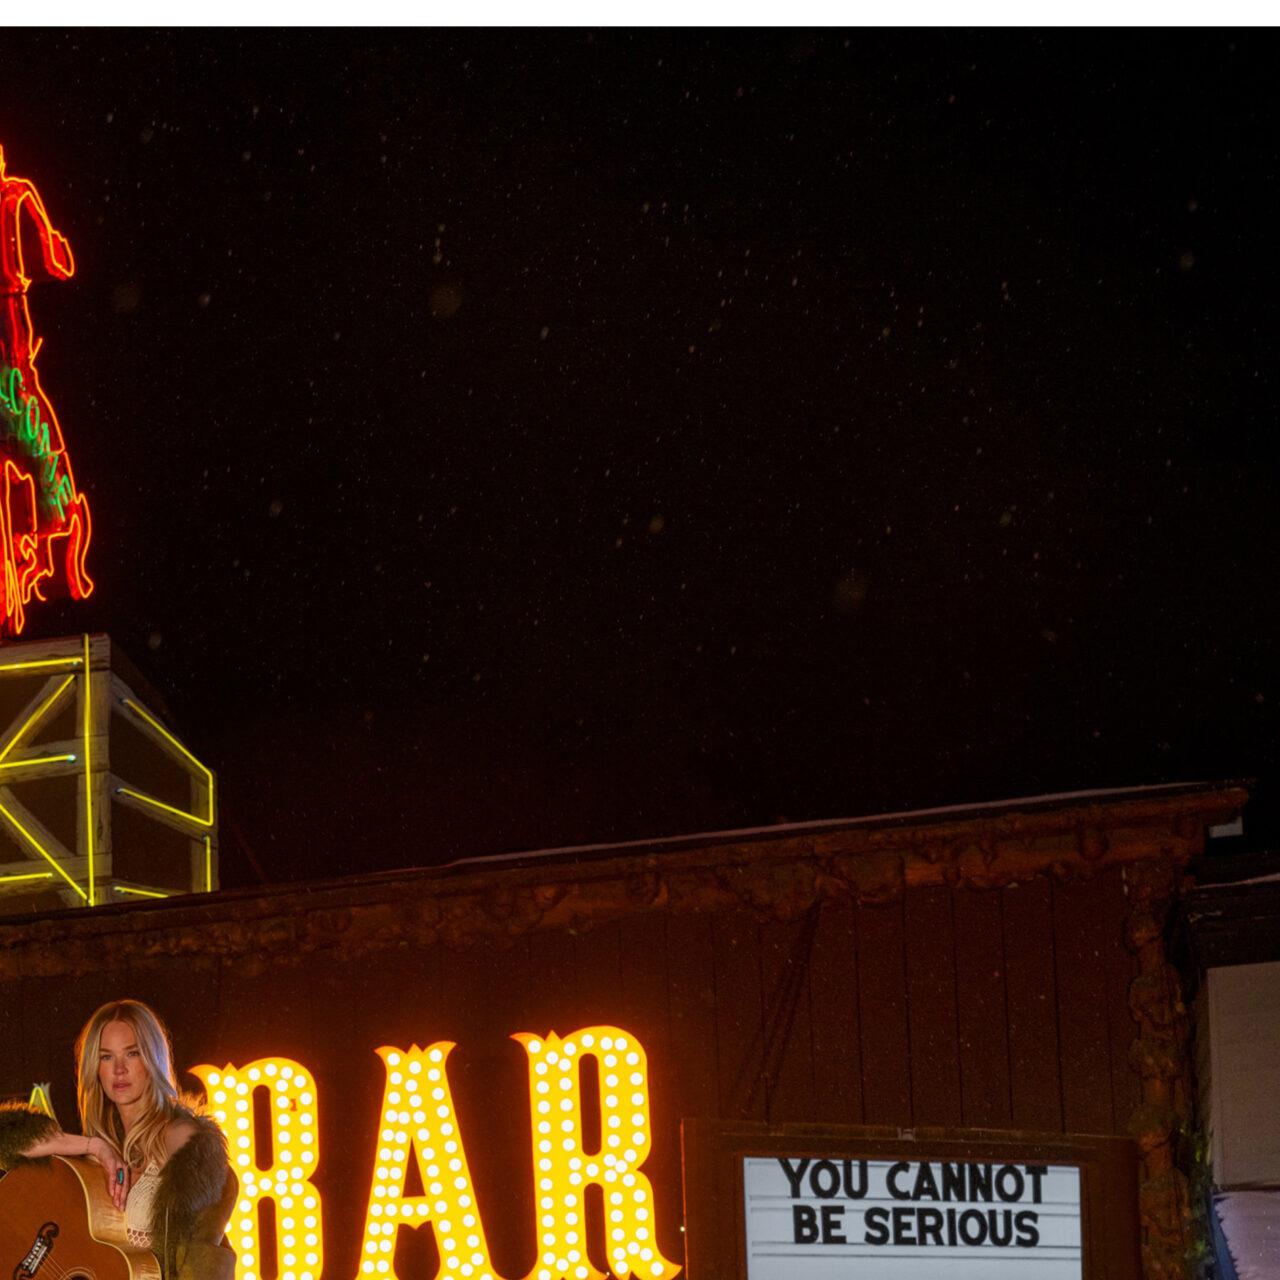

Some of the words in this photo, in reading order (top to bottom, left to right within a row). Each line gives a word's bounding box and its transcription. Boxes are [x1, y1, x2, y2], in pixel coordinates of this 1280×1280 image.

[777, 1158, 869, 1199] YOU
[886, 1161, 1048, 1204] CANNOT
[792, 1205, 847, 1244] BE
[864, 1207, 1040, 1247] SERIOUS
